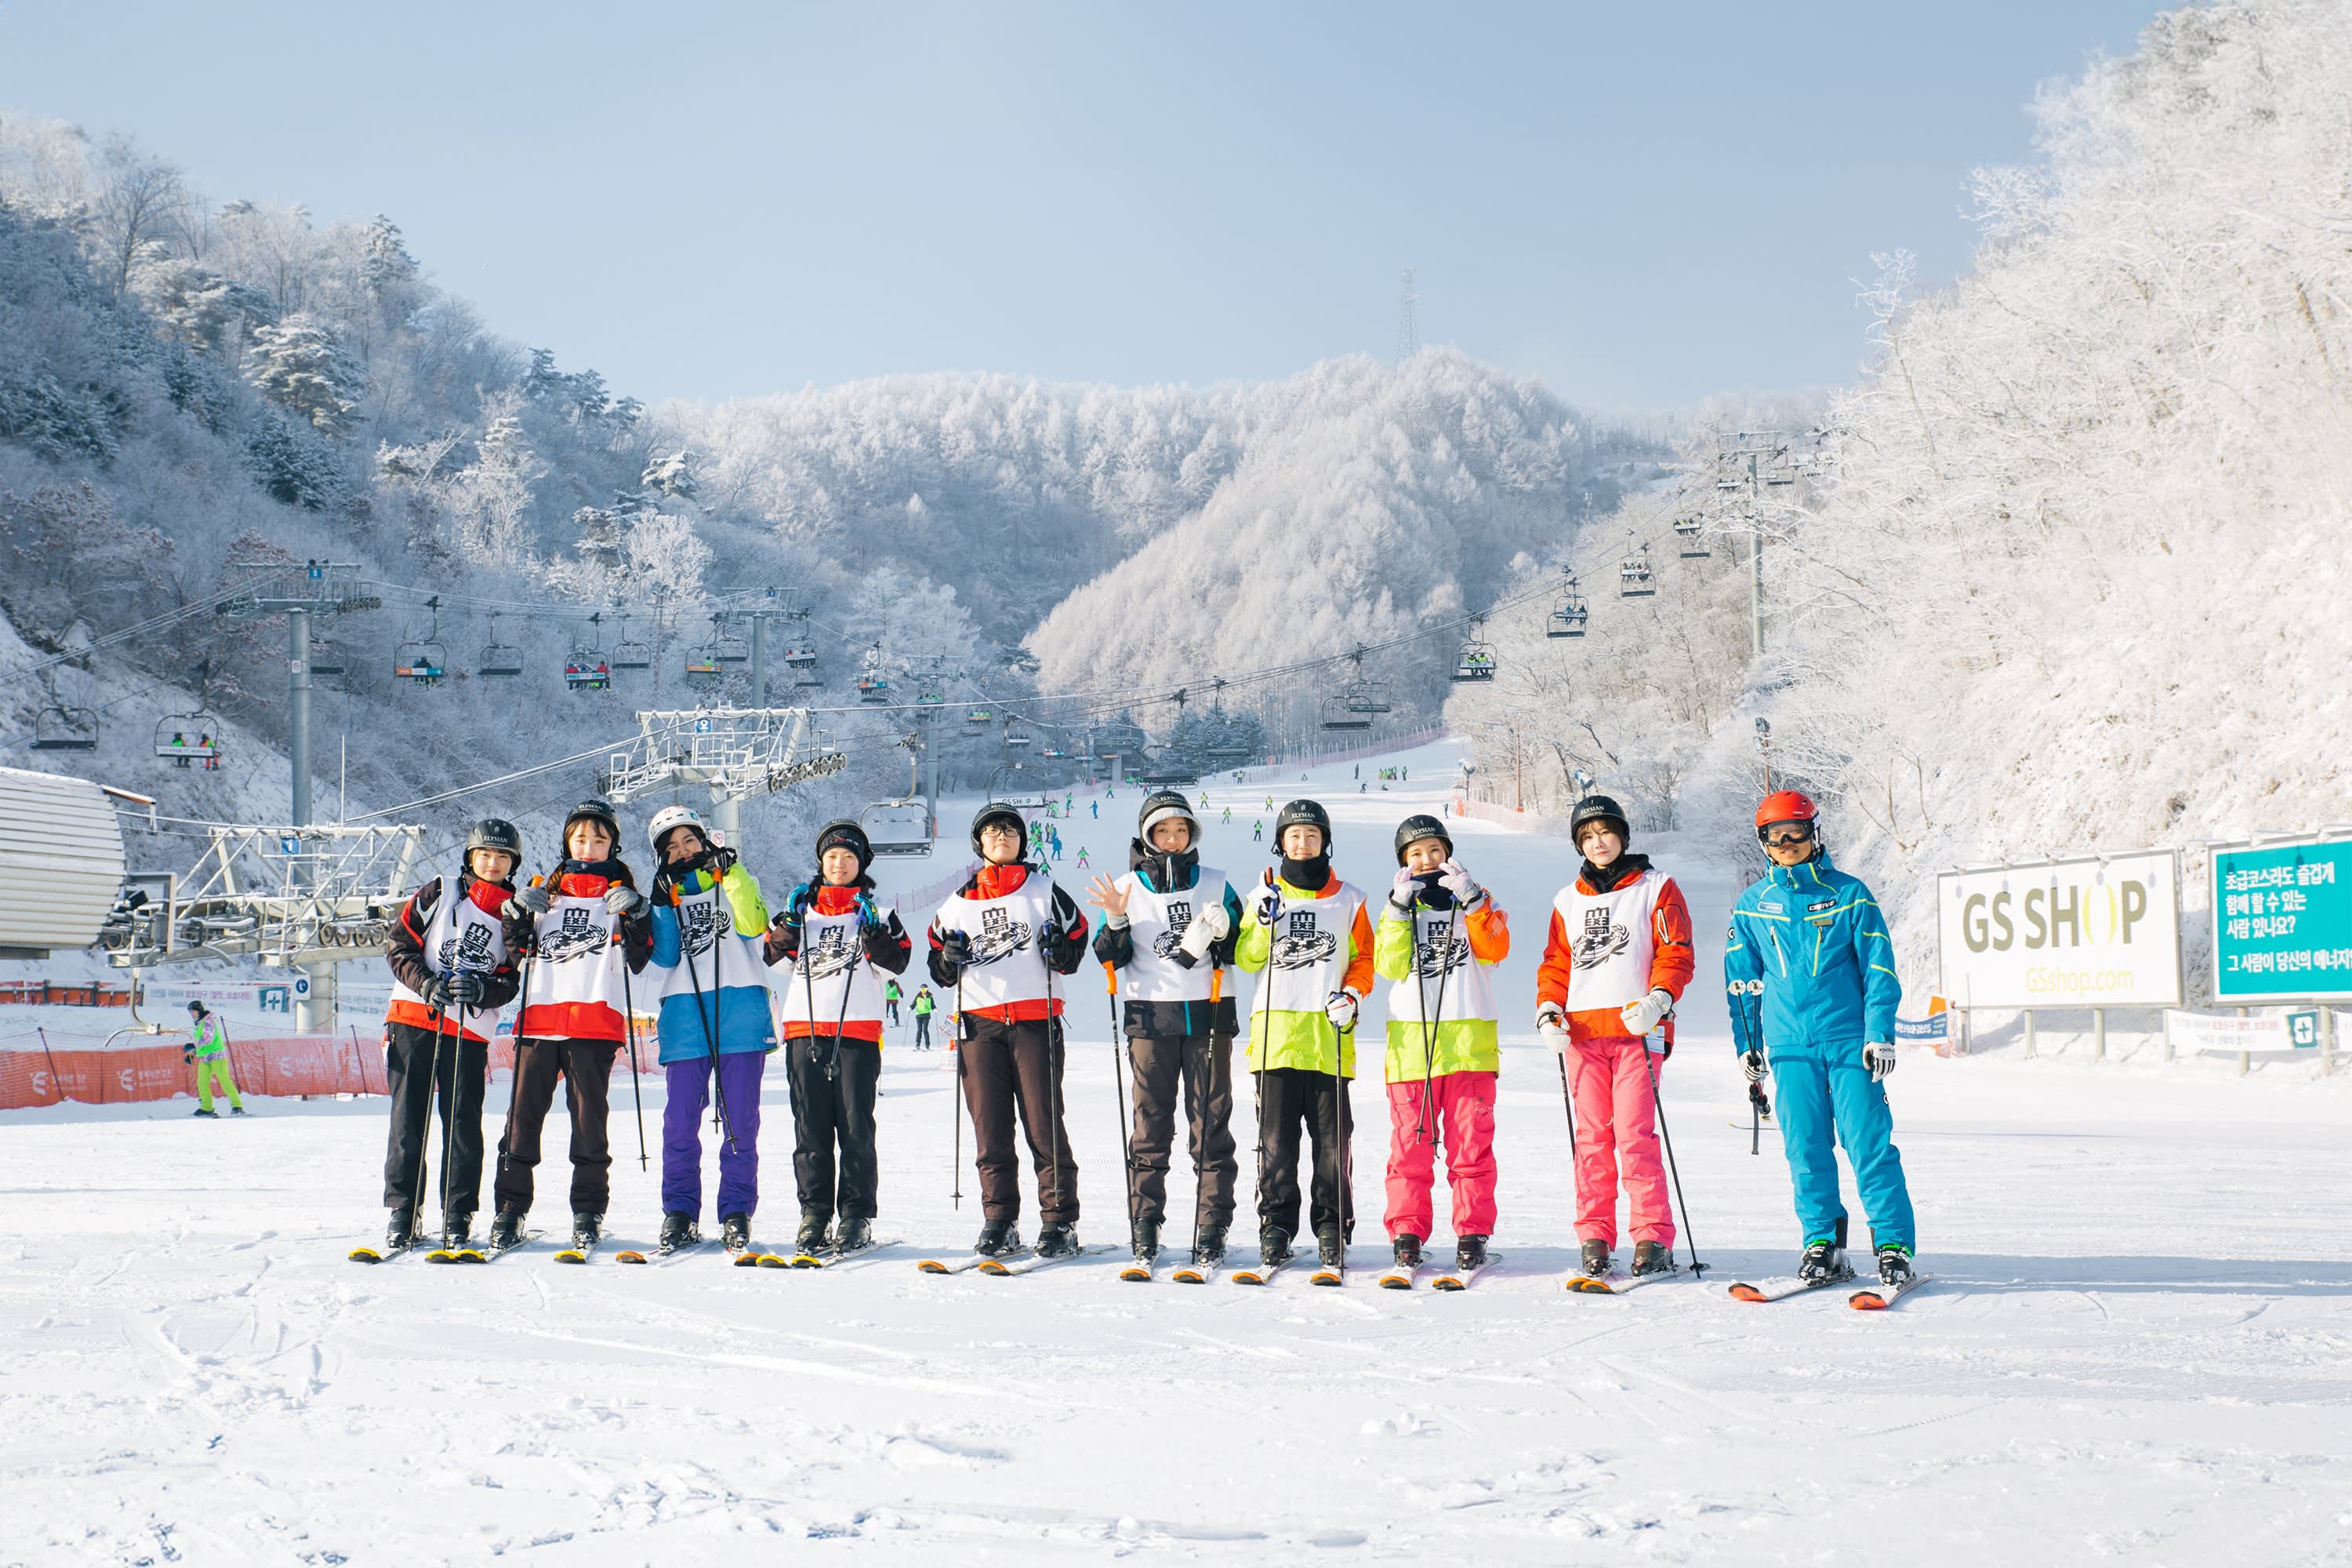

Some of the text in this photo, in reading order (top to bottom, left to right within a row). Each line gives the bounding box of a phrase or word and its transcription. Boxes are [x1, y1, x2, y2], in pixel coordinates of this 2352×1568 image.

[1581, 805, 1605, 815] ELYSIAN
[1411, 826, 1436, 836] ELYSIAN
[2225, 861, 2335, 891] 초급코스라도 즐겁게
[2225, 890, 2307, 916] 함께 할 수 있는
[1962, 891, 2014, 953] GS
[2227, 916, 2296, 939] 사람 있나요?
[2227, 948, 2352, 973] 그 사람이 당신의 에너지
[2025, 966, 2134, 997] GSshop.com
